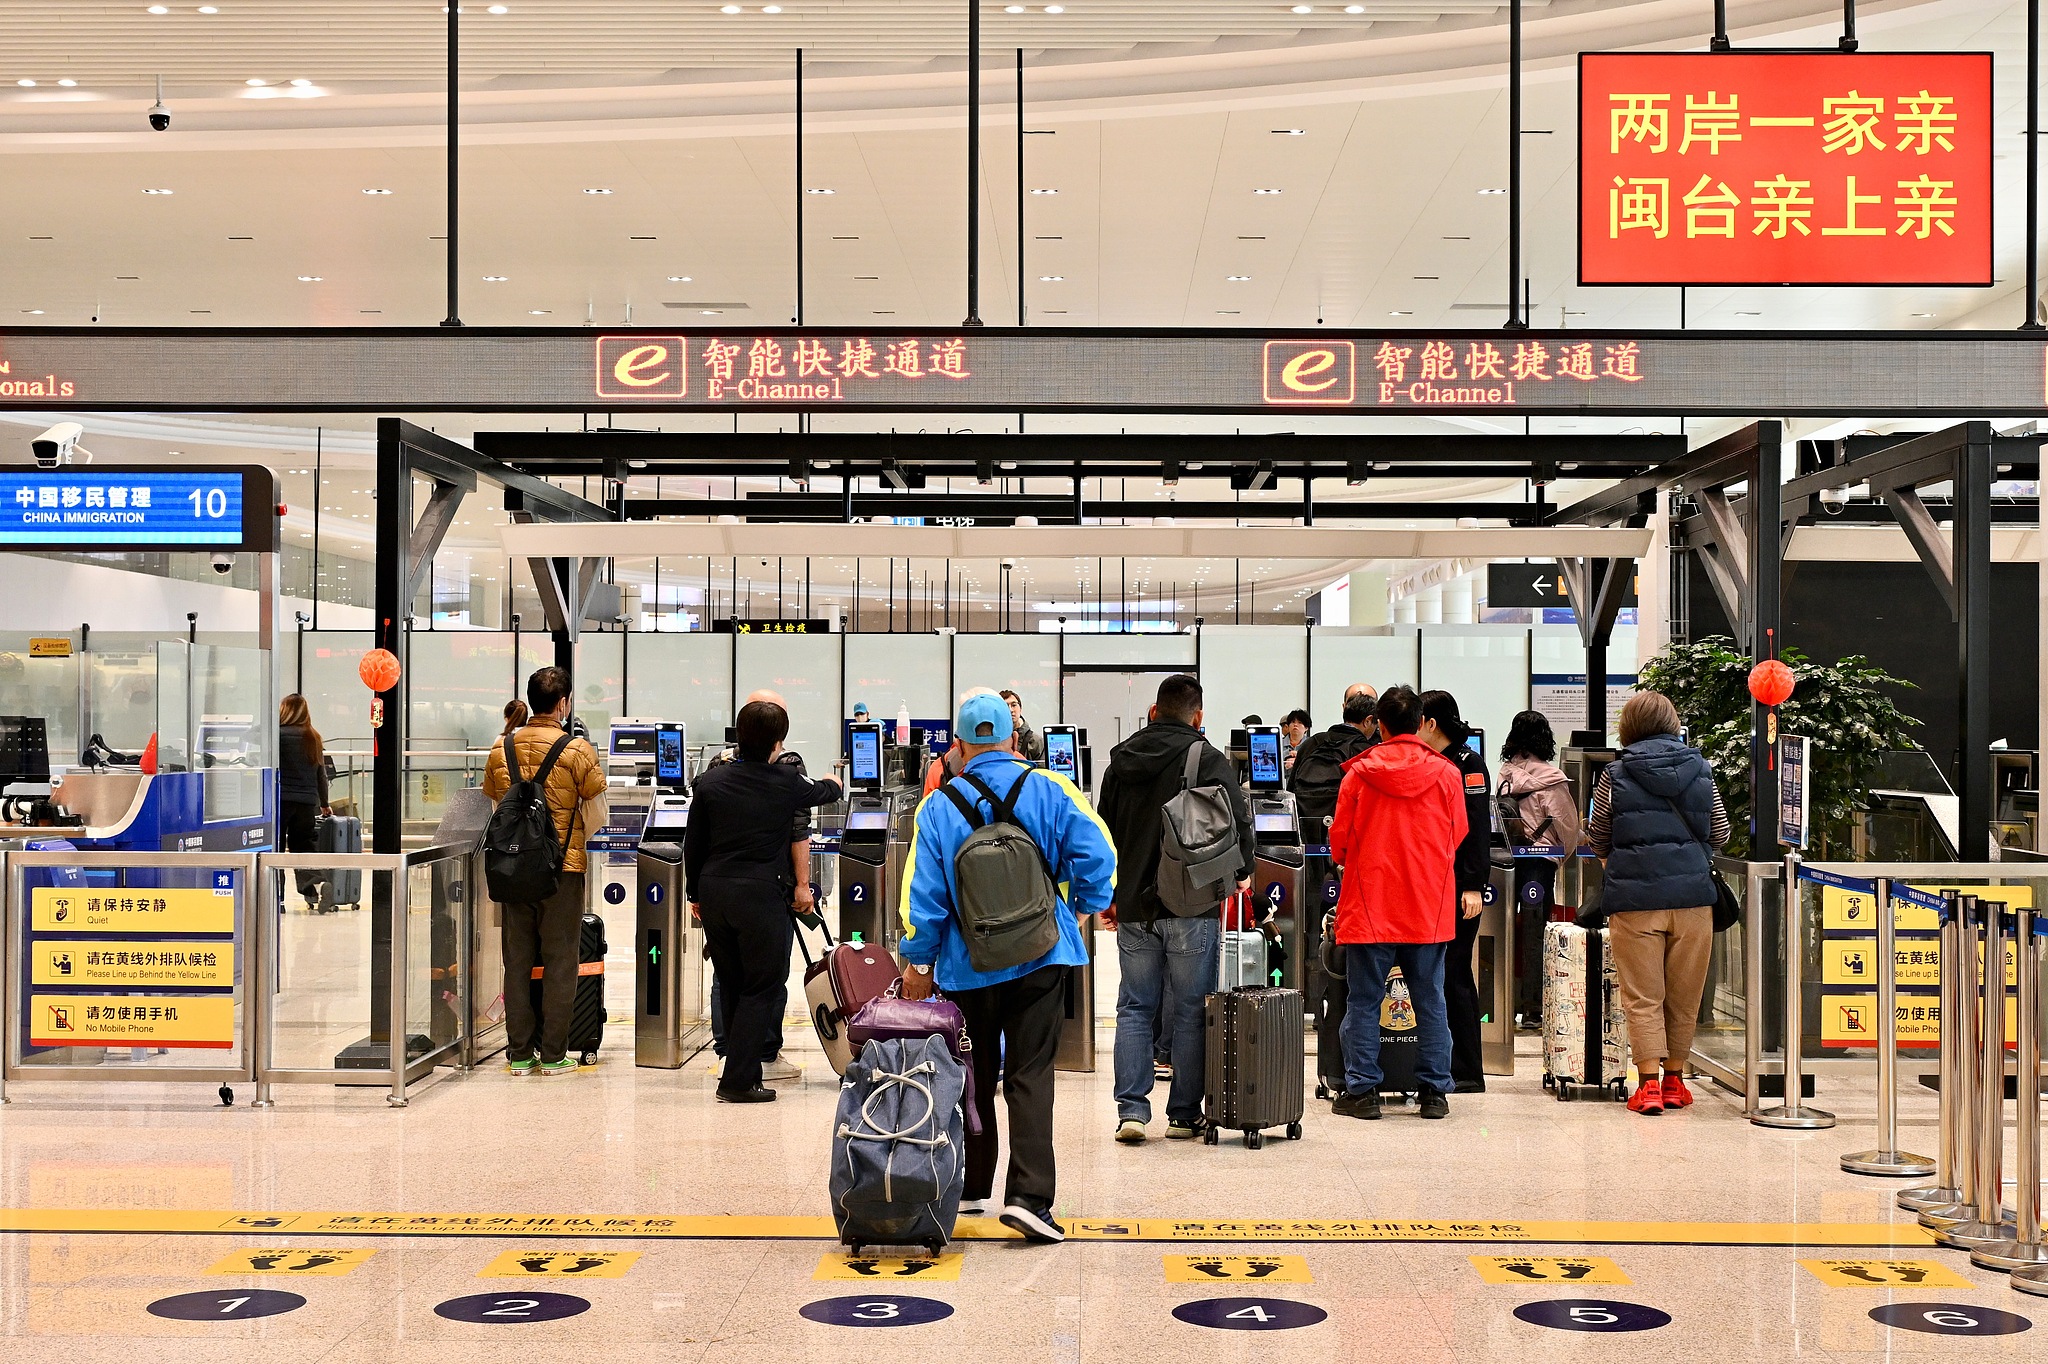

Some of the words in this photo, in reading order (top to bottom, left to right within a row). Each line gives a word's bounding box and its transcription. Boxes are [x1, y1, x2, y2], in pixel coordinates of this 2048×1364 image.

[1608, 89, 1958, 156] 两岸一家亲
[1608, 173, 1959, 240] 闽台亲上亲
[701, 338, 971, 380] 智能快捷通道
[1373, 341, 1645, 382] 智能快捷通道
[707, 377, 845, 400] E-Channel
[1378, 382, 1516, 404] E-Channel
[15, 486, 152, 508] 中国移民管理
[188, 488, 227, 519] 10
[23, 512, 61, 524] CHINA
[63, 512, 145, 524] IMMIGRATION
[761, 622, 807, 634] 卫生检疫
[218, 875, 230, 887] 推
[650, 886, 658, 902] 1
[853, 885, 863, 901] 2
[1270, 885, 1281, 901] 4
[1328, 886, 1337, 898] 5
[1528, 887, 1537, 899] 6
[87, 898, 167, 912] 请保持安静
[87, 915, 109, 925] Quiet
[86, 951, 218, 967] 请在黄线外排队候检
[86, 969, 111, 978] Please
[112, 969, 127, 979] Line
[129, 971, 137, 980] up
[140, 970, 164, 979] Behind
[165, 970, 176, 979] the
[178, 970, 201, 980] Yellow
[202, 971, 217, 980] Line
[1905, 969, 1921, 978] Line
[86, 1005, 179, 1021] 请勿使用手机
[85, 1024, 98, 1032] No
[99, 1024, 126, 1033] Mobile
[128, 1024, 154, 1033] Phone
[329, 1216, 677, 1227] 请在黄线外排队候检
[1172, 1223, 1525, 1231] 请在黄线外排队候检
[217, 1296, 251, 1313] 1
[481, 1299, 540, 1316] 2
[851, 1302, 900, 1320] 3
[1225, 1305, 1277, 1322] 4
[1569, 1307, 1619, 1324] 5
[1922, 1310, 1979, 1328] 6
